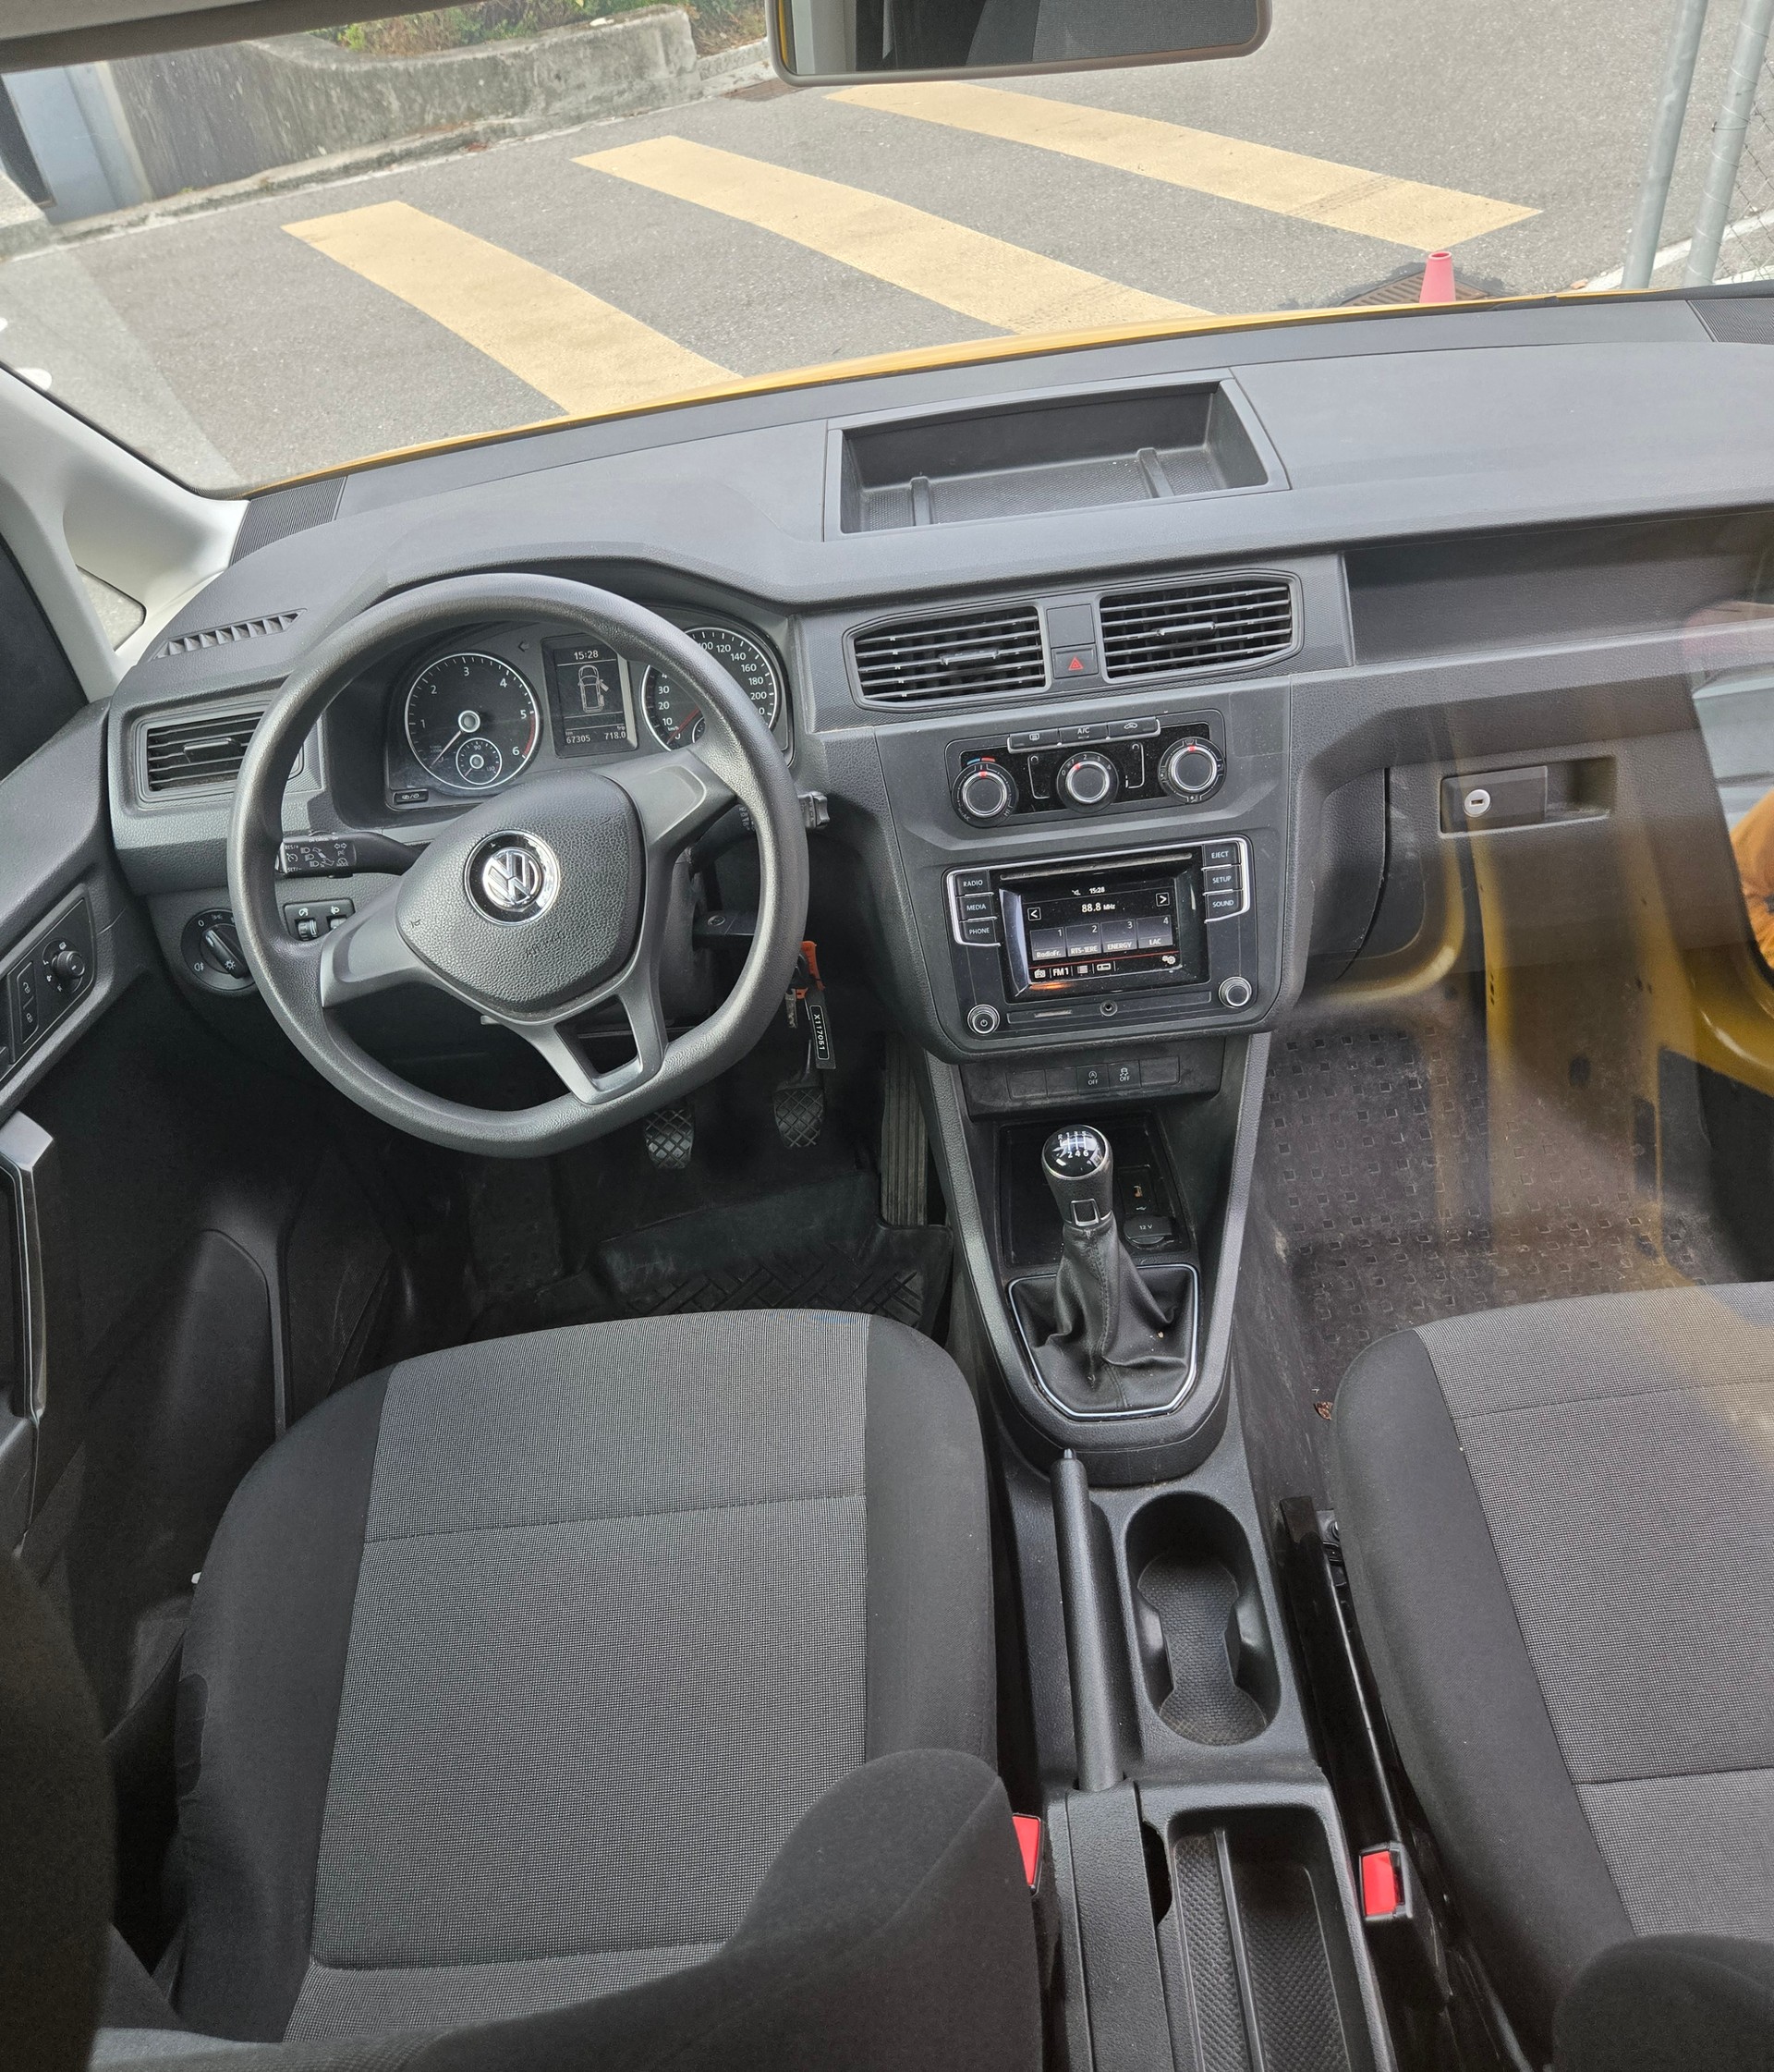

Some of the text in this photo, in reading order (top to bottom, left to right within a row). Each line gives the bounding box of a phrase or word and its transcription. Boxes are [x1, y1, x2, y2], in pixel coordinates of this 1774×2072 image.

[716, 643, 731, 652] 120
[574, 650, 599, 660] 15:28
[730, 652, 747, 662] 140
[463, 666, 470, 676] 3
[741, 663, 757, 673] 160
[500, 677, 507, 689] 4
[747, 676, 764, 686] 180
[431, 685, 438, 695] 2
[658, 685, 670, 695] 30
[750, 691, 767, 701] 200
[658, 701, 670, 711] 20
[520, 710, 527, 720] 5
[420, 719, 426, 729] 1
[662, 717, 673, 725] 10
[565, 730, 626, 744] 67305 718.0
[512, 746, 520, 756] 6
[1210, 850, 1229, 859] EJECT
[963, 879, 983, 887] RADIO
[1212, 875, 1232, 884] SETUP
[966, 903, 987, 911] MEDIA
[1081, 902, 1101, 913] 88.8
[1212, 899, 1234, 908] SOUND
[1127, 920, 1133, 929] 3
[1163, 916, 1169, 924] 4
[1057, 929, 1063, 937] 1
[1091, 925, 1098, 933] 2
[1107, 942, 1133, 950] ENERGY
[1067, 1151, 1073, 1159] 2
[1083, 1149, 1089, 1157] 6
